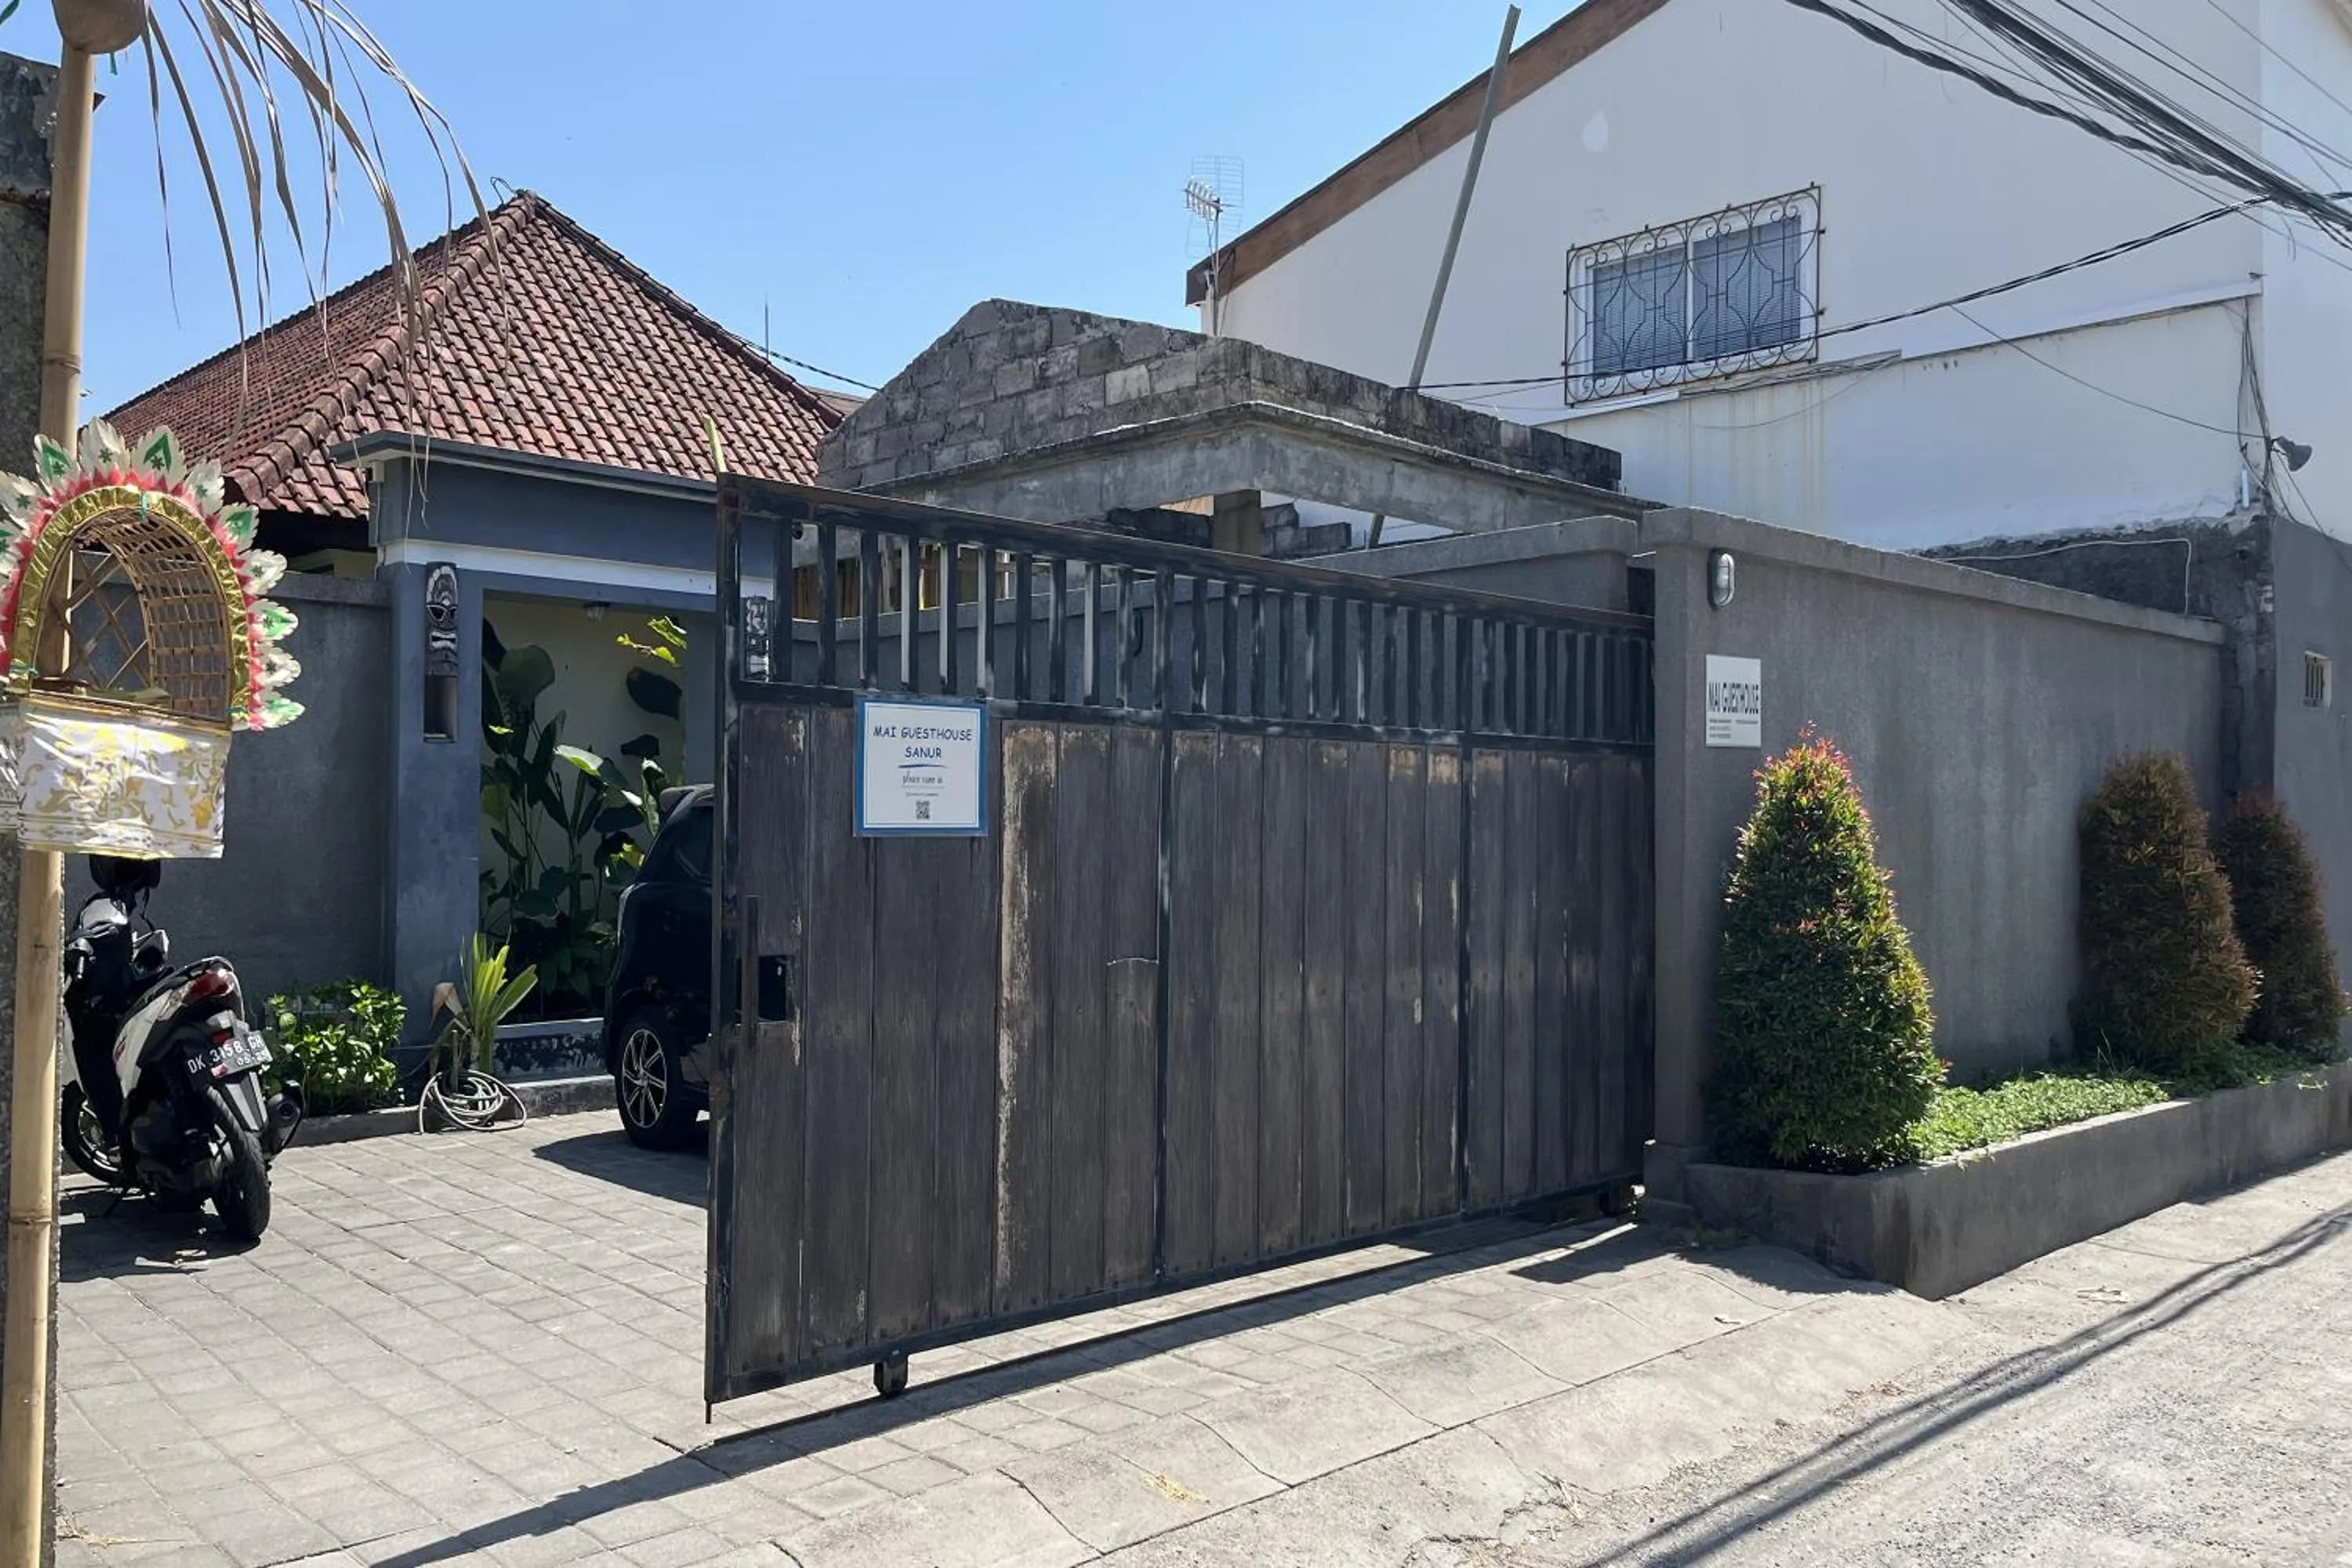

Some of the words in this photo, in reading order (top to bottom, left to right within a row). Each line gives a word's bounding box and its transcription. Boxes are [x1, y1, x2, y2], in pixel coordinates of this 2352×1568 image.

[1708, 681, 1721, 713] MAI
[1722, 681, 1759, 715] GUESTHOUSE
[873, 725, 896, 738] MAI
[901, 727, 973, 741] GUESTHOUSE
[904, 746, 942, 759] SANUR
[187, 1054, 206, 1074] DK
[209, 1040, 243, 1062] 3158
